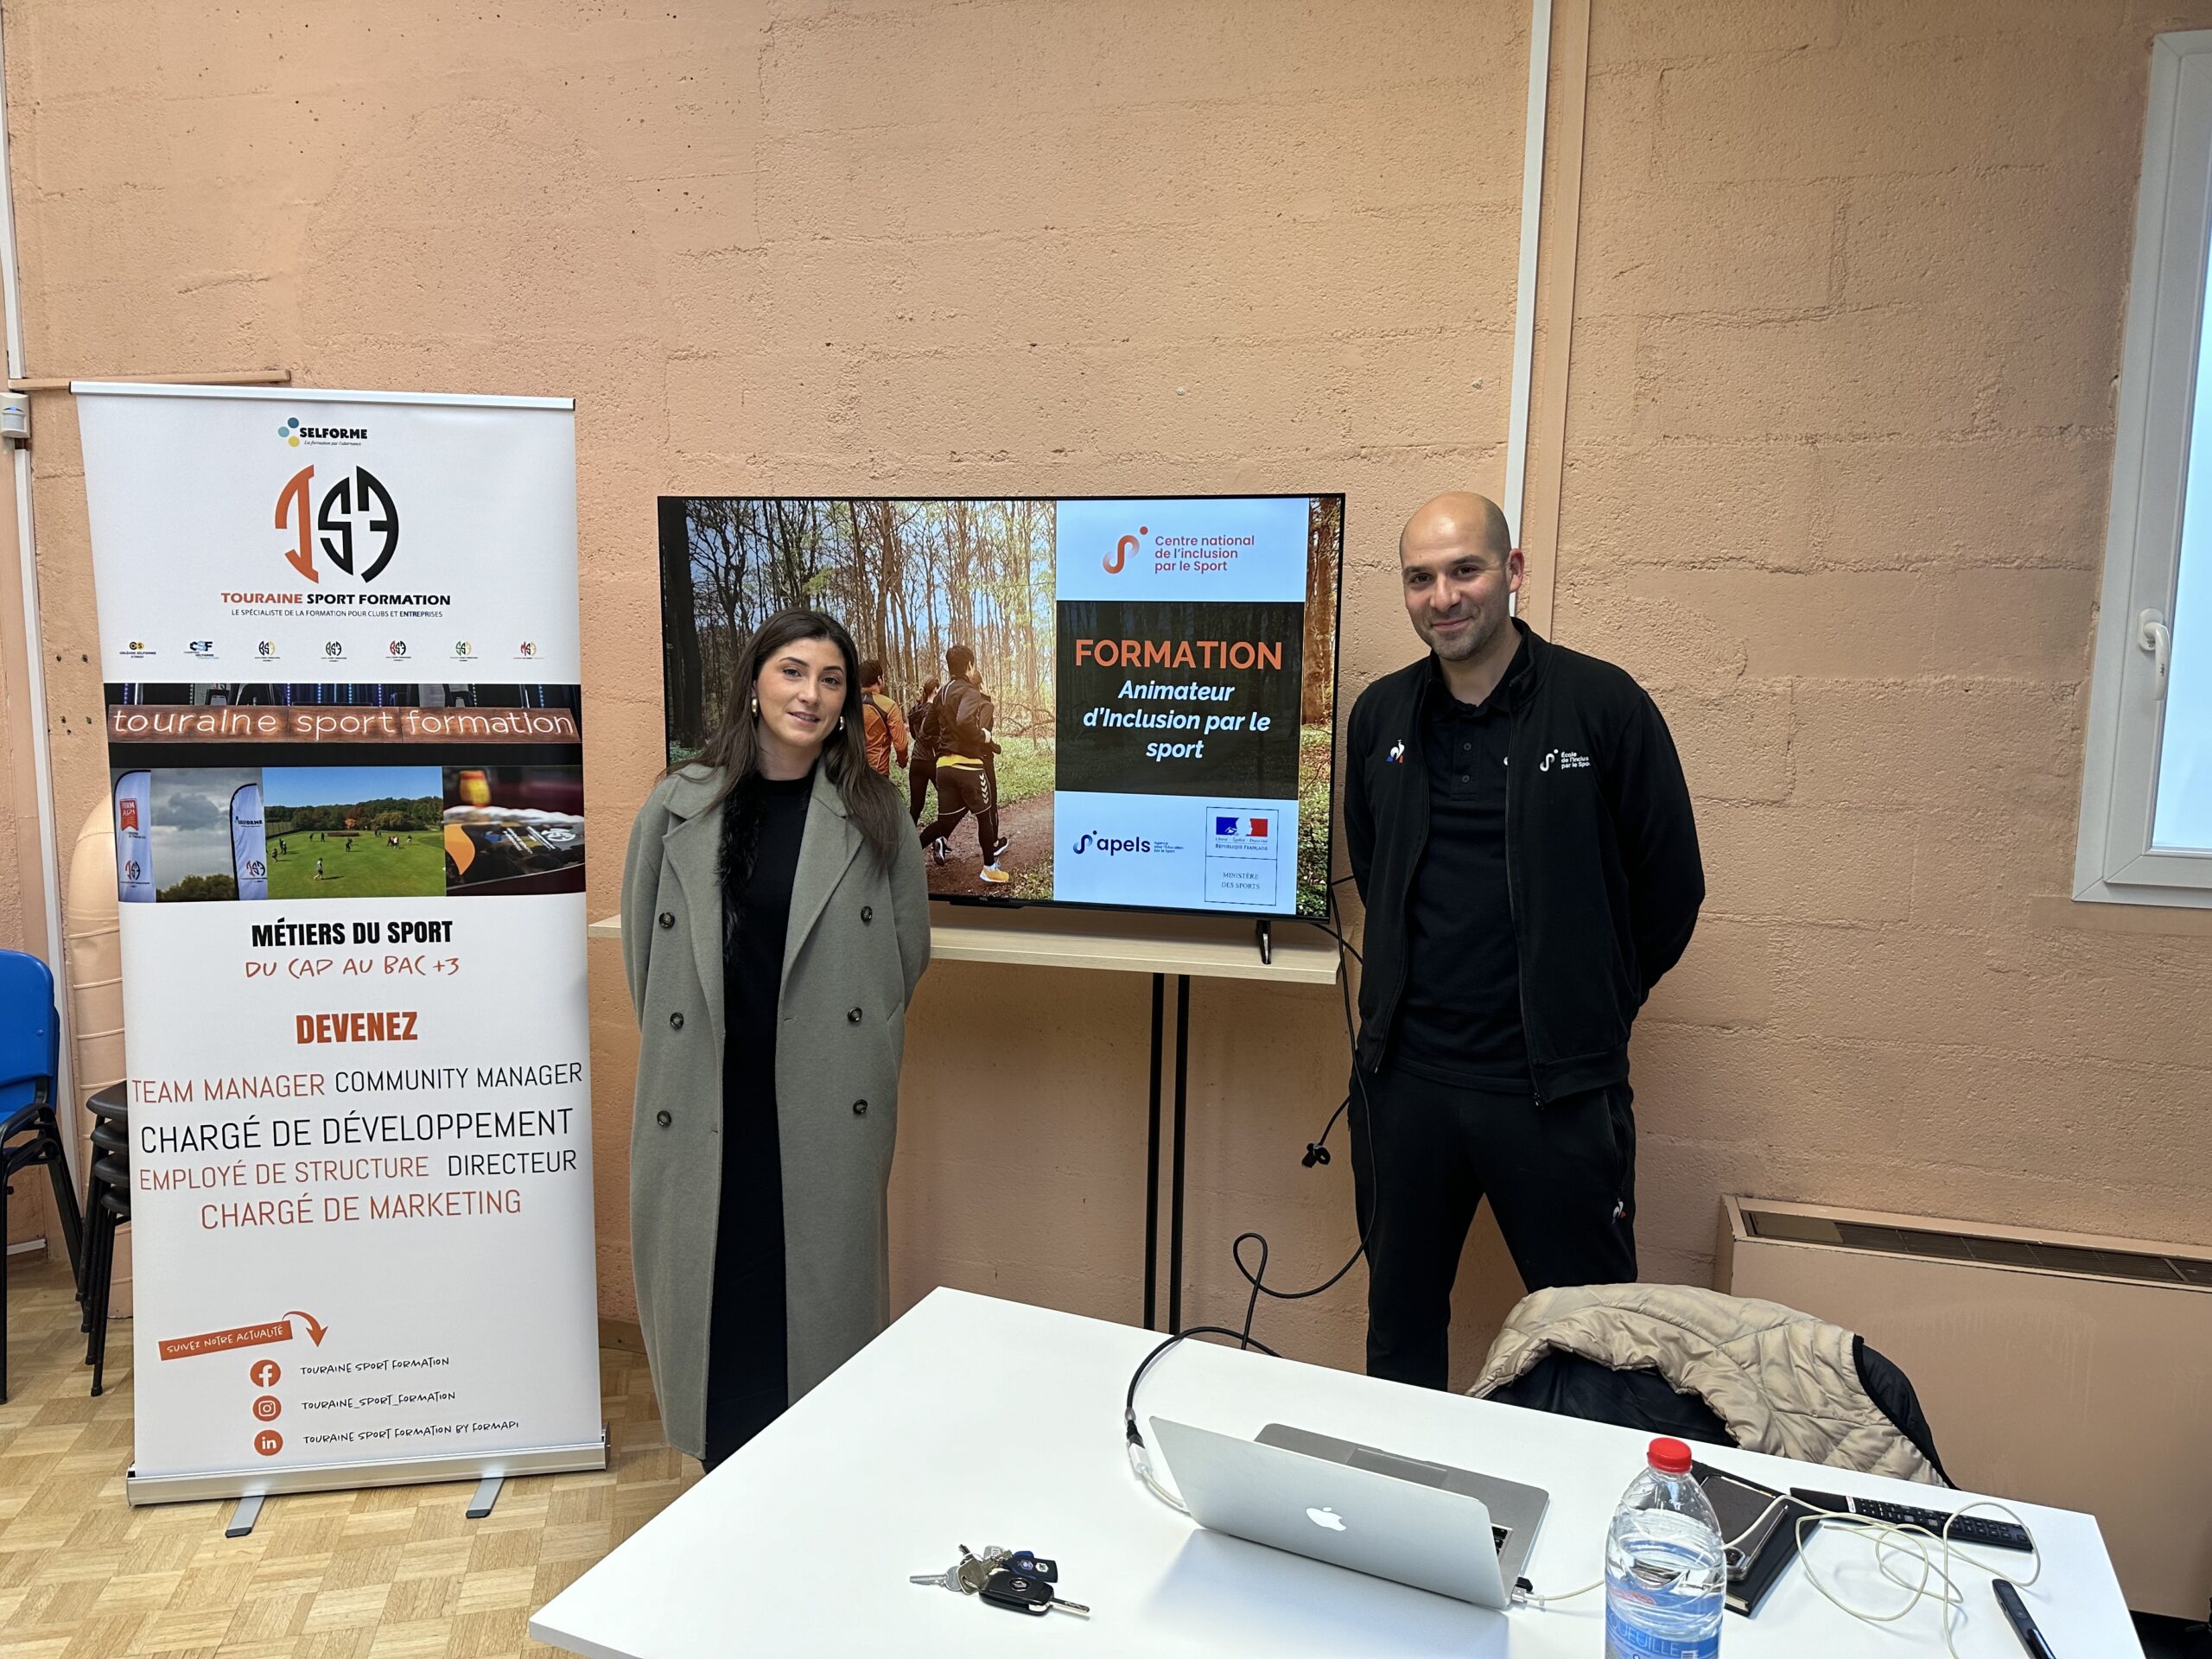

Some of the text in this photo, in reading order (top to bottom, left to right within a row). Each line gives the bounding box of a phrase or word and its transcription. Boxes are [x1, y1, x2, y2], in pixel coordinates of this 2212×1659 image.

[299, 428, 367, 439] SELFORME
[1155, 535, 1255, 546] Centre national
[1155, 549, 1237, 559] de l'inclusion
[1154, 561, 1228, 574] par le Sport
[221, 593, 450, 605] TOURAINE SPORT FORMATION
[1076, 639, 1283, 670] FORMATION
[1118, 680, 1235, 701] Animateur
[113, 709, 574, 741] touraine sport formation
[1083, 708, 1271, 734] d'Inclusion par le
[1146, 741, 1205, 761] sport
[1096, 836, 1151, 855] apels
[251, 917, 453, 947] MÉTIERS DU SPORT
[245, 962, 277, 978] DU
[289, 957, 334, 979] CAP
[343, 958, 373, 976] AU
[384, 955, 426, 976] BAC
[296, 1011, 418, 1044] DEVENEZ
[132, 1062, 582, 1103] TEAM MANAGER COMMUNITY MANAGER
[141, 1108, 573, 1154] CHARGÉ DE DÉVELOPPEMENT
[140, 1149, 576, 1191] EMPLOYÉ DE STRUCTURE DIRECTEUR
[201, 1189, 521, 1230] CHARGÉ DE MARKETING
[167, 1325, 283, 1353] SUIVEZ NOTRE ACTUALITÉ
[300, 1357, 449, 1375] TOURAINE SPORT FORMATION
[302, 1432, 354, 1444] TOURAINE
[358, 1428, 392, 1440] SPORT
[395, 1425, 452, 1438] FORMATION
[455, 1423, 469, 1434] BY
